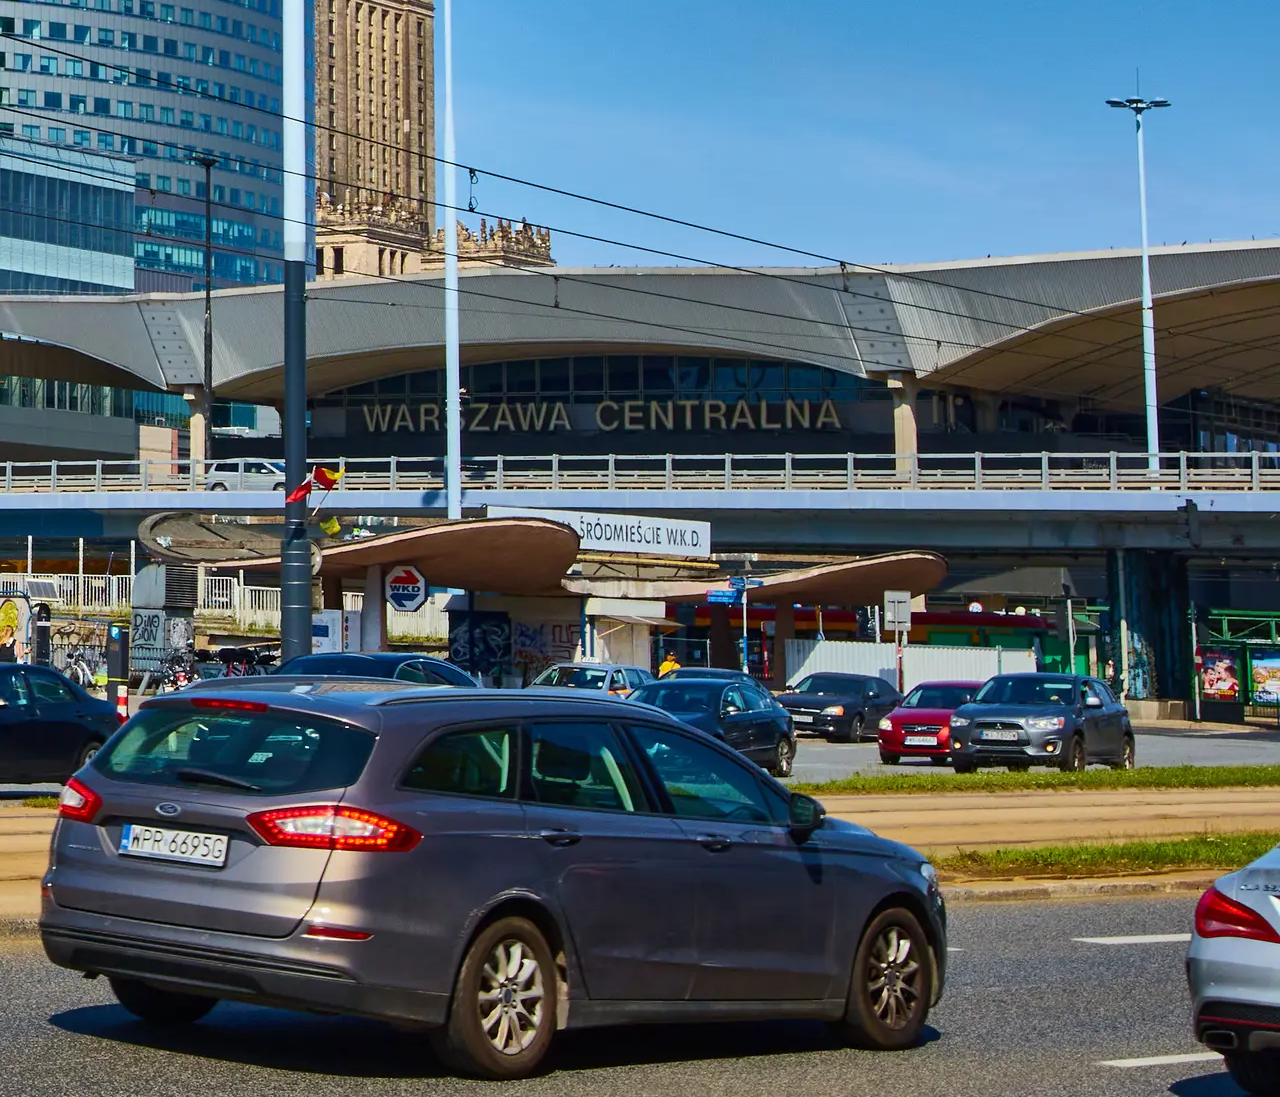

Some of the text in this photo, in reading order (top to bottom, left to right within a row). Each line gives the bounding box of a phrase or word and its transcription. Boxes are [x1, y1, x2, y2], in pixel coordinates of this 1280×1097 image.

[362, 399, 842, 433] WARZAWA CENTRALNA
[579, 515, 702, 548] ŚRÓDMIEŚCIE W.K.D.
[389, 584, 421, 593] WKD
[130, 824, 224, 860] WPR 6695G
